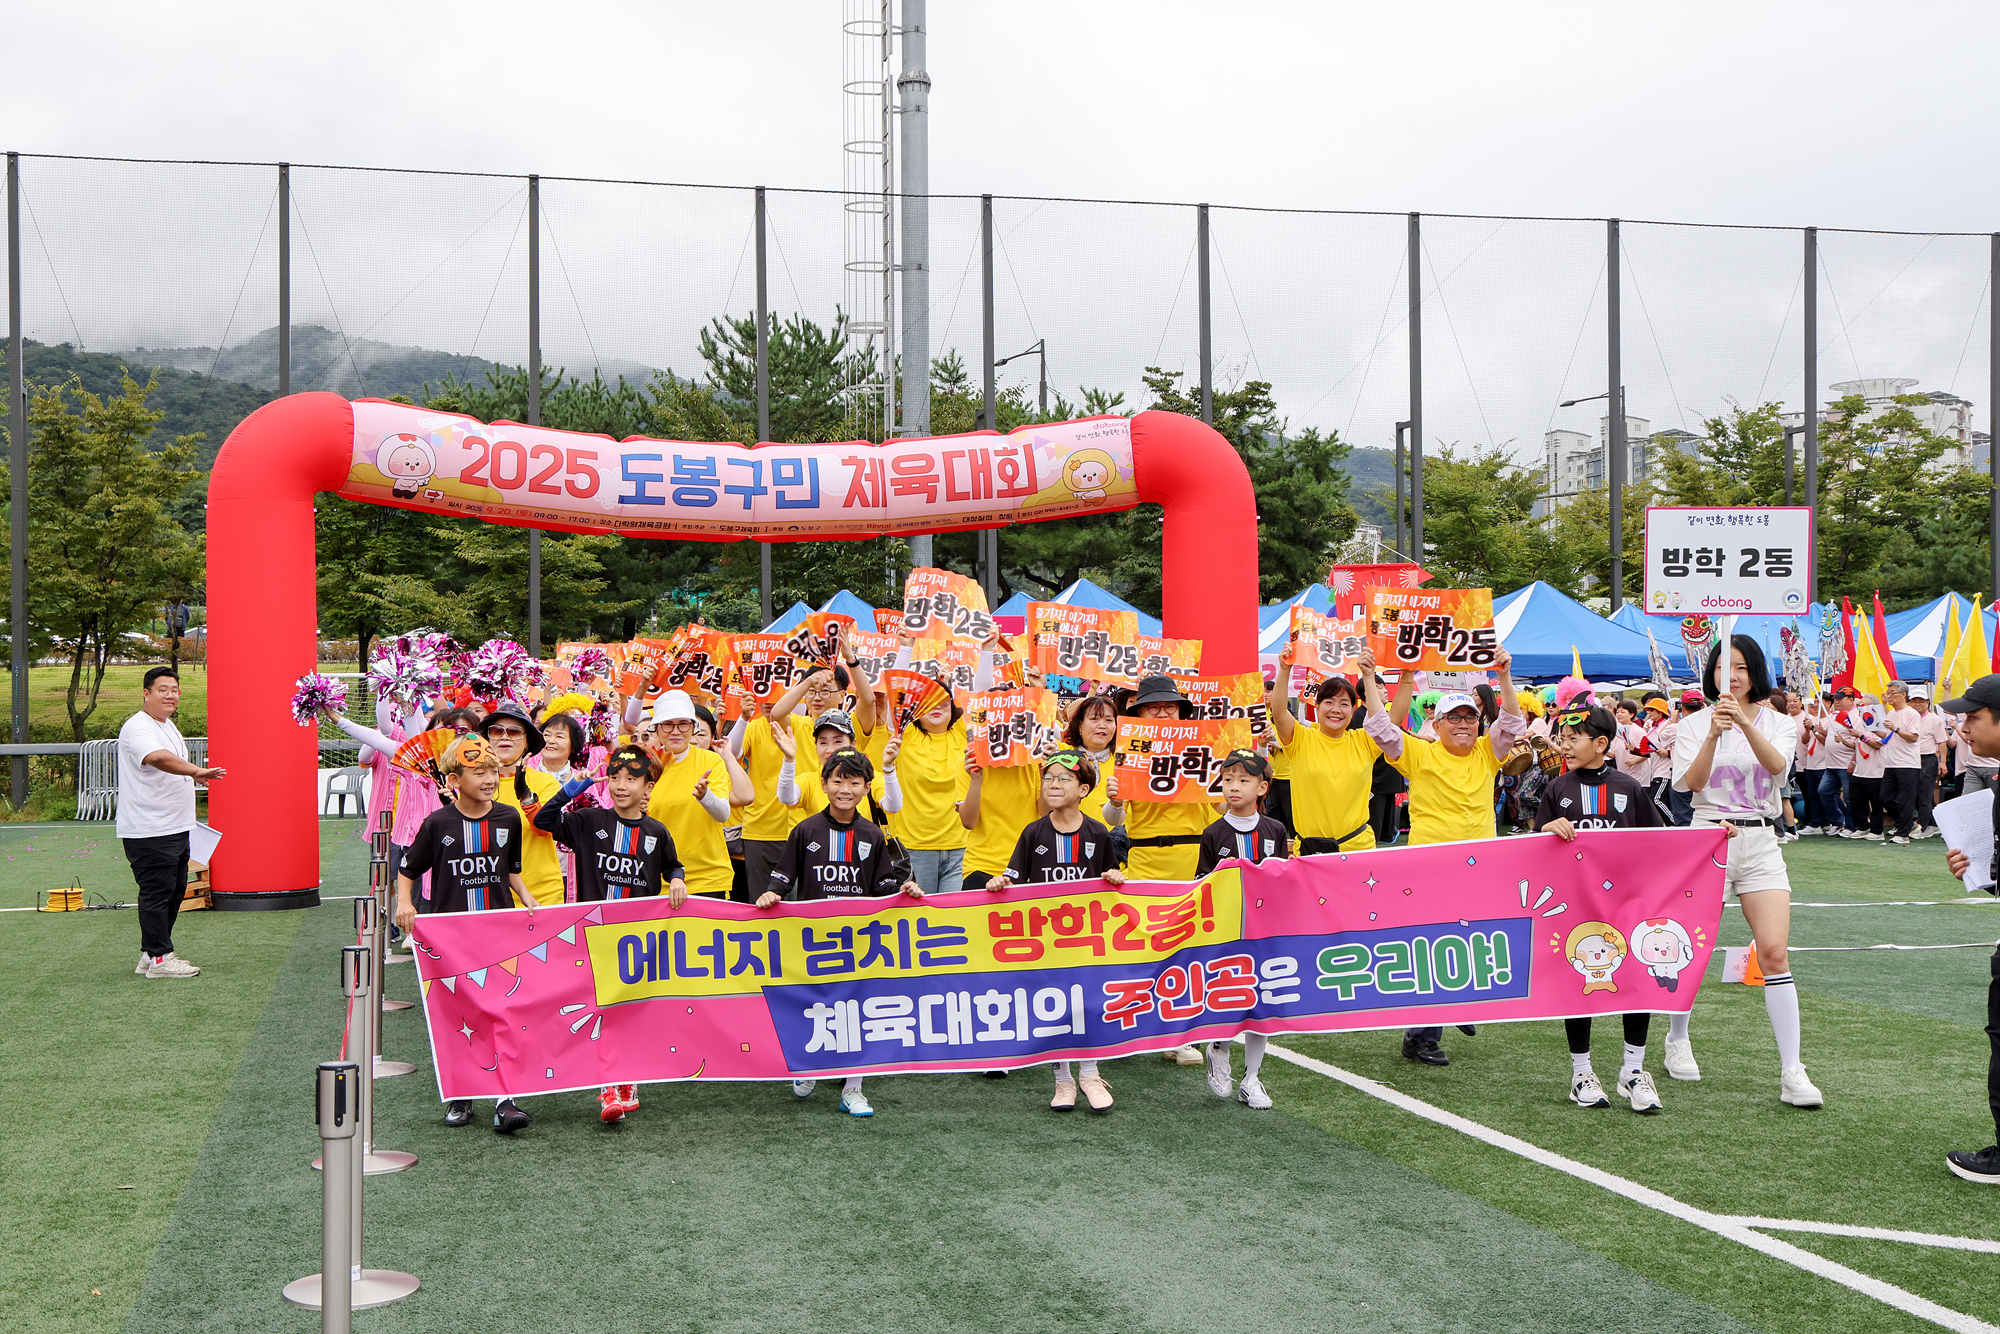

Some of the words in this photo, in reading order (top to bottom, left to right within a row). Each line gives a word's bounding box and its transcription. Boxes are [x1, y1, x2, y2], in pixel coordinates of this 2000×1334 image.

[459, 435, 600, 499] 2025
[618, 453, 820, 510] 도봉구민
[842, 443, 1038, 508] 체육대회
[498, 508, 512, 516] 20.
[516, 509, 532, 518] (토)
[534, 512, 558, 521] 09:00
[568, 516, 590, 524] 17:00
[614, 520, 672, 530] 다락원체육공원
[1687, 515, 1703, 526] 같이
[1706, 514, 1725, 526] 변화,
[1728, 514, 1754, 526] 행복한
[1756, 514, 1770, 526] 도봉
[1662, 547, 1726, 578] 방학
[1739, 548, 1793, 578] 2동
[918, 572, 948, 587] 이기자!
[1373, 592, 1407, 607] 즐기자!
[1409, 595, 1440, 609] 이기자!
[1701, 595, 1752, 610] dobong
[904, 592, 994, 643] 방학2동
[1036, 607, 1066, 620] 즐기자!
[1068, 613, 1098, 626] 이기자!
[1296, 608, 1323, 627] 즐기자!
[1324, 621, 1355, 633] 이기자!
[1381, 608, 1419, 622] 도봉에서
[1042, 621, 1078, 634] 도봉에서
[866, 638, 896, 648] 이기자!
[1399, 616, 1496, 665] 방학2동
[1059, 631, 1139, 678] 방학2동
[1192, 681, 1218, 692] 이기자!
[992, 695, 1024, 708] 이기자!
[1120, 724, 1158, 739] 즐기자!
[1161, 727, 1199, 740] 이기자!
[1128, 739, 1174, 754] 도봉에서
[1114, 752, 1151, 769] 짱되는
[448, 856, 500, 876] TORY
[596, 852, 644, 876] TORY
[460, 876, 488, 886] Football
[604, 872, 632, 884] Football
[632, 878, 648, 887] Club
[812, 865, 860, 883] TORY
[1041, 866, 1088, 882] TORY
[823, 884, 850, 894] Football
[617, 928, 783, 985] 에너지
[802, 917, 969, 977] 넘치는
[988, 883, 1216, 963] 방학2동!
[803, 984, 1086, 1053] 체육대회의
[1102, 954, 1301, 1030] 주인공은
[1316, 930, 1512, 1001] 우리야!
